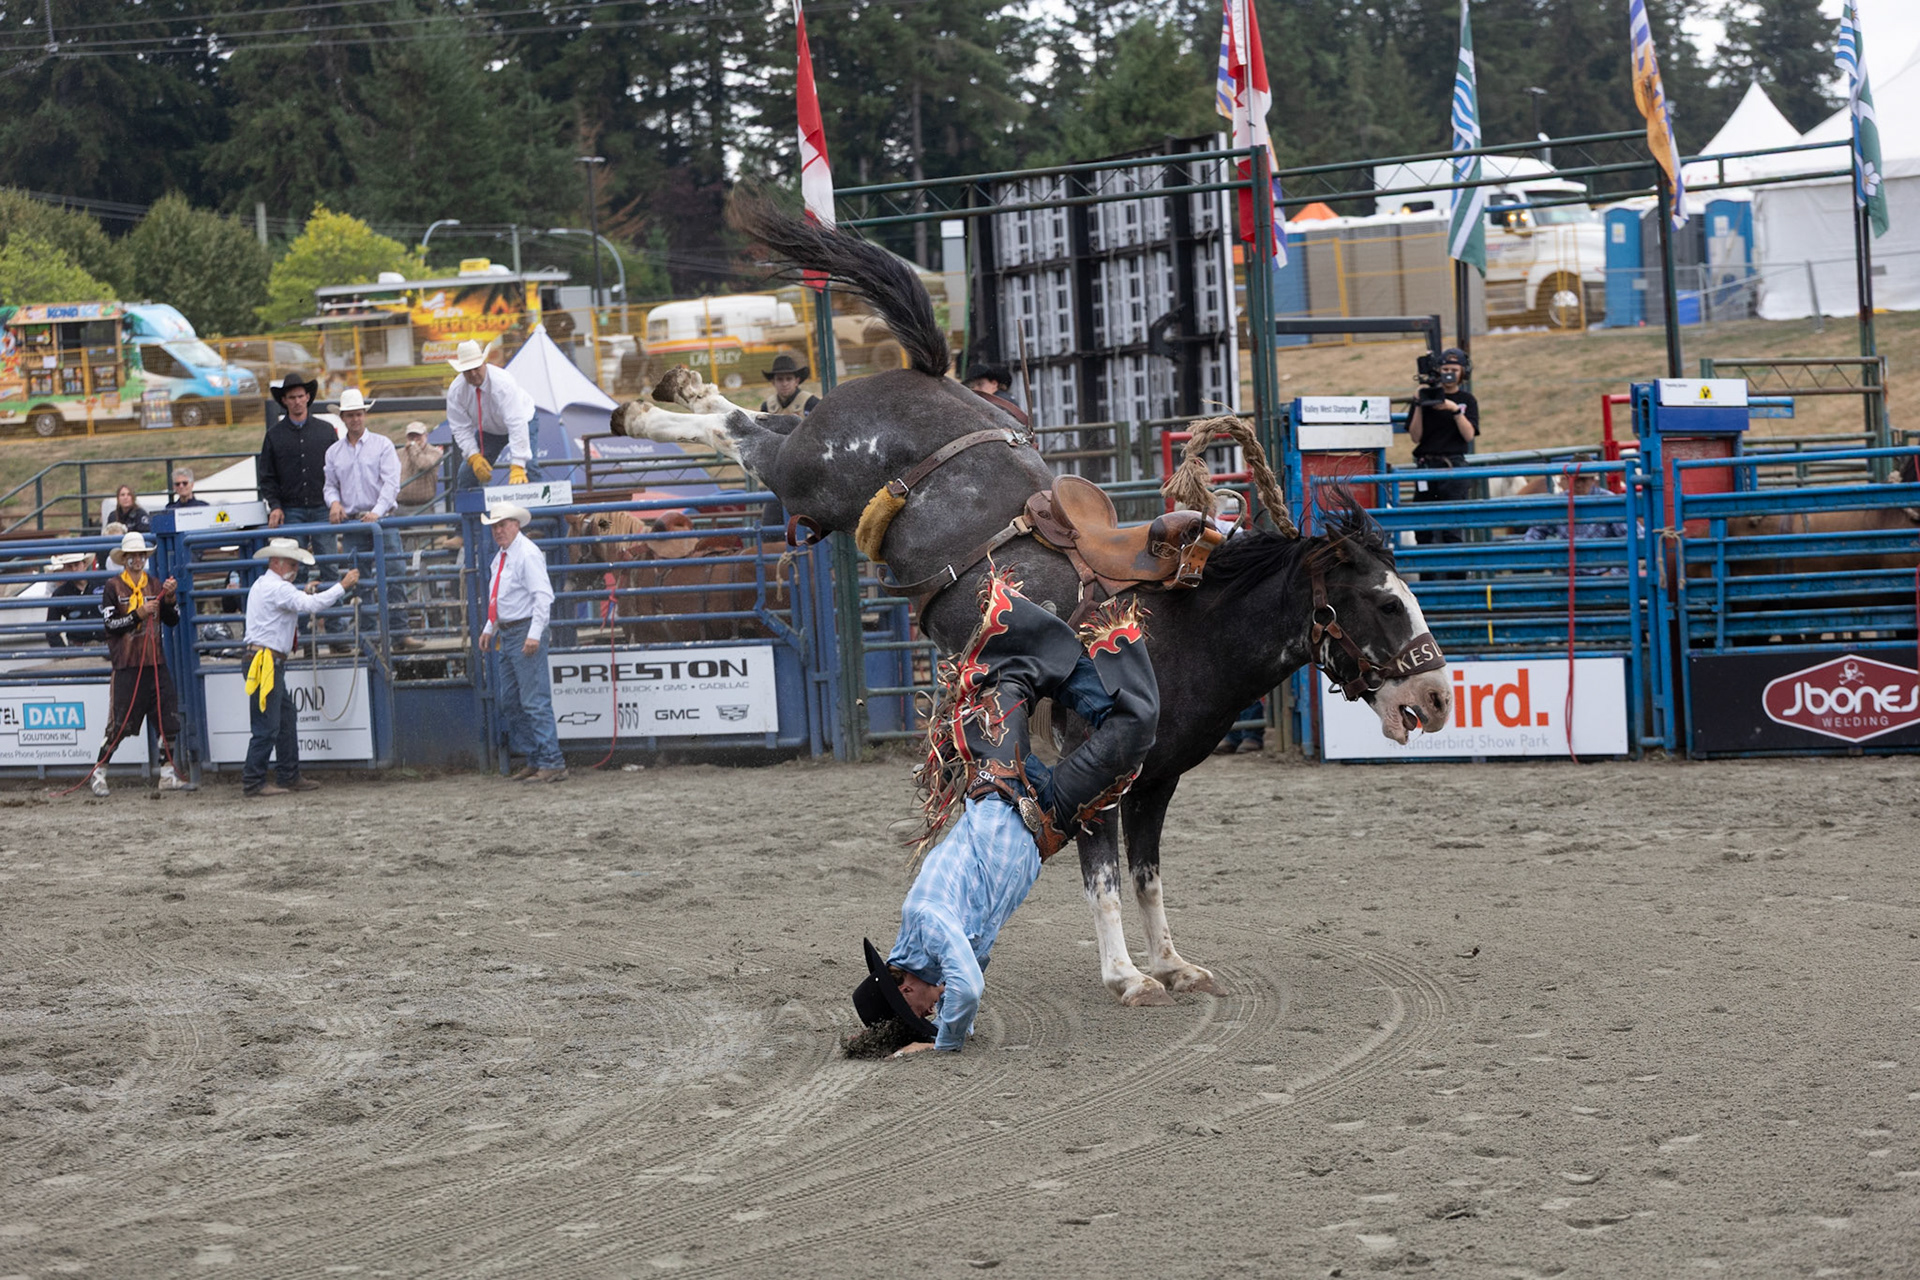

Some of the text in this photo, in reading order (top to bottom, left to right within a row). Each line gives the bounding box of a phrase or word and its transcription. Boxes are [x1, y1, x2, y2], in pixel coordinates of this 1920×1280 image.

[1304, 405, 1357, 414] Valley West Stampede
[487, 492, 539, 504] Valley West Stampede
[552, 658, 749, 684] PRESTON
[553, 681, 750, 696] CHEVROLET BUICK GMC CADILLAC
[1452, 668, 1550, 728] ird.
[28, 706, 81, 726] DATA
[655, 708, 700, 721] GMC
[1822, 715, 1890, 728] WELDING
[22, 732, 74, 742] SOLUTIONS INC.
[1392, 733, 1550, 750] underbird Show Park
[15, 750, 35, 759] Phone
[35, 750, 60, 760] Systems
[61, 750, 67, 758] &
[68, 748, 92, 759] Cabling
